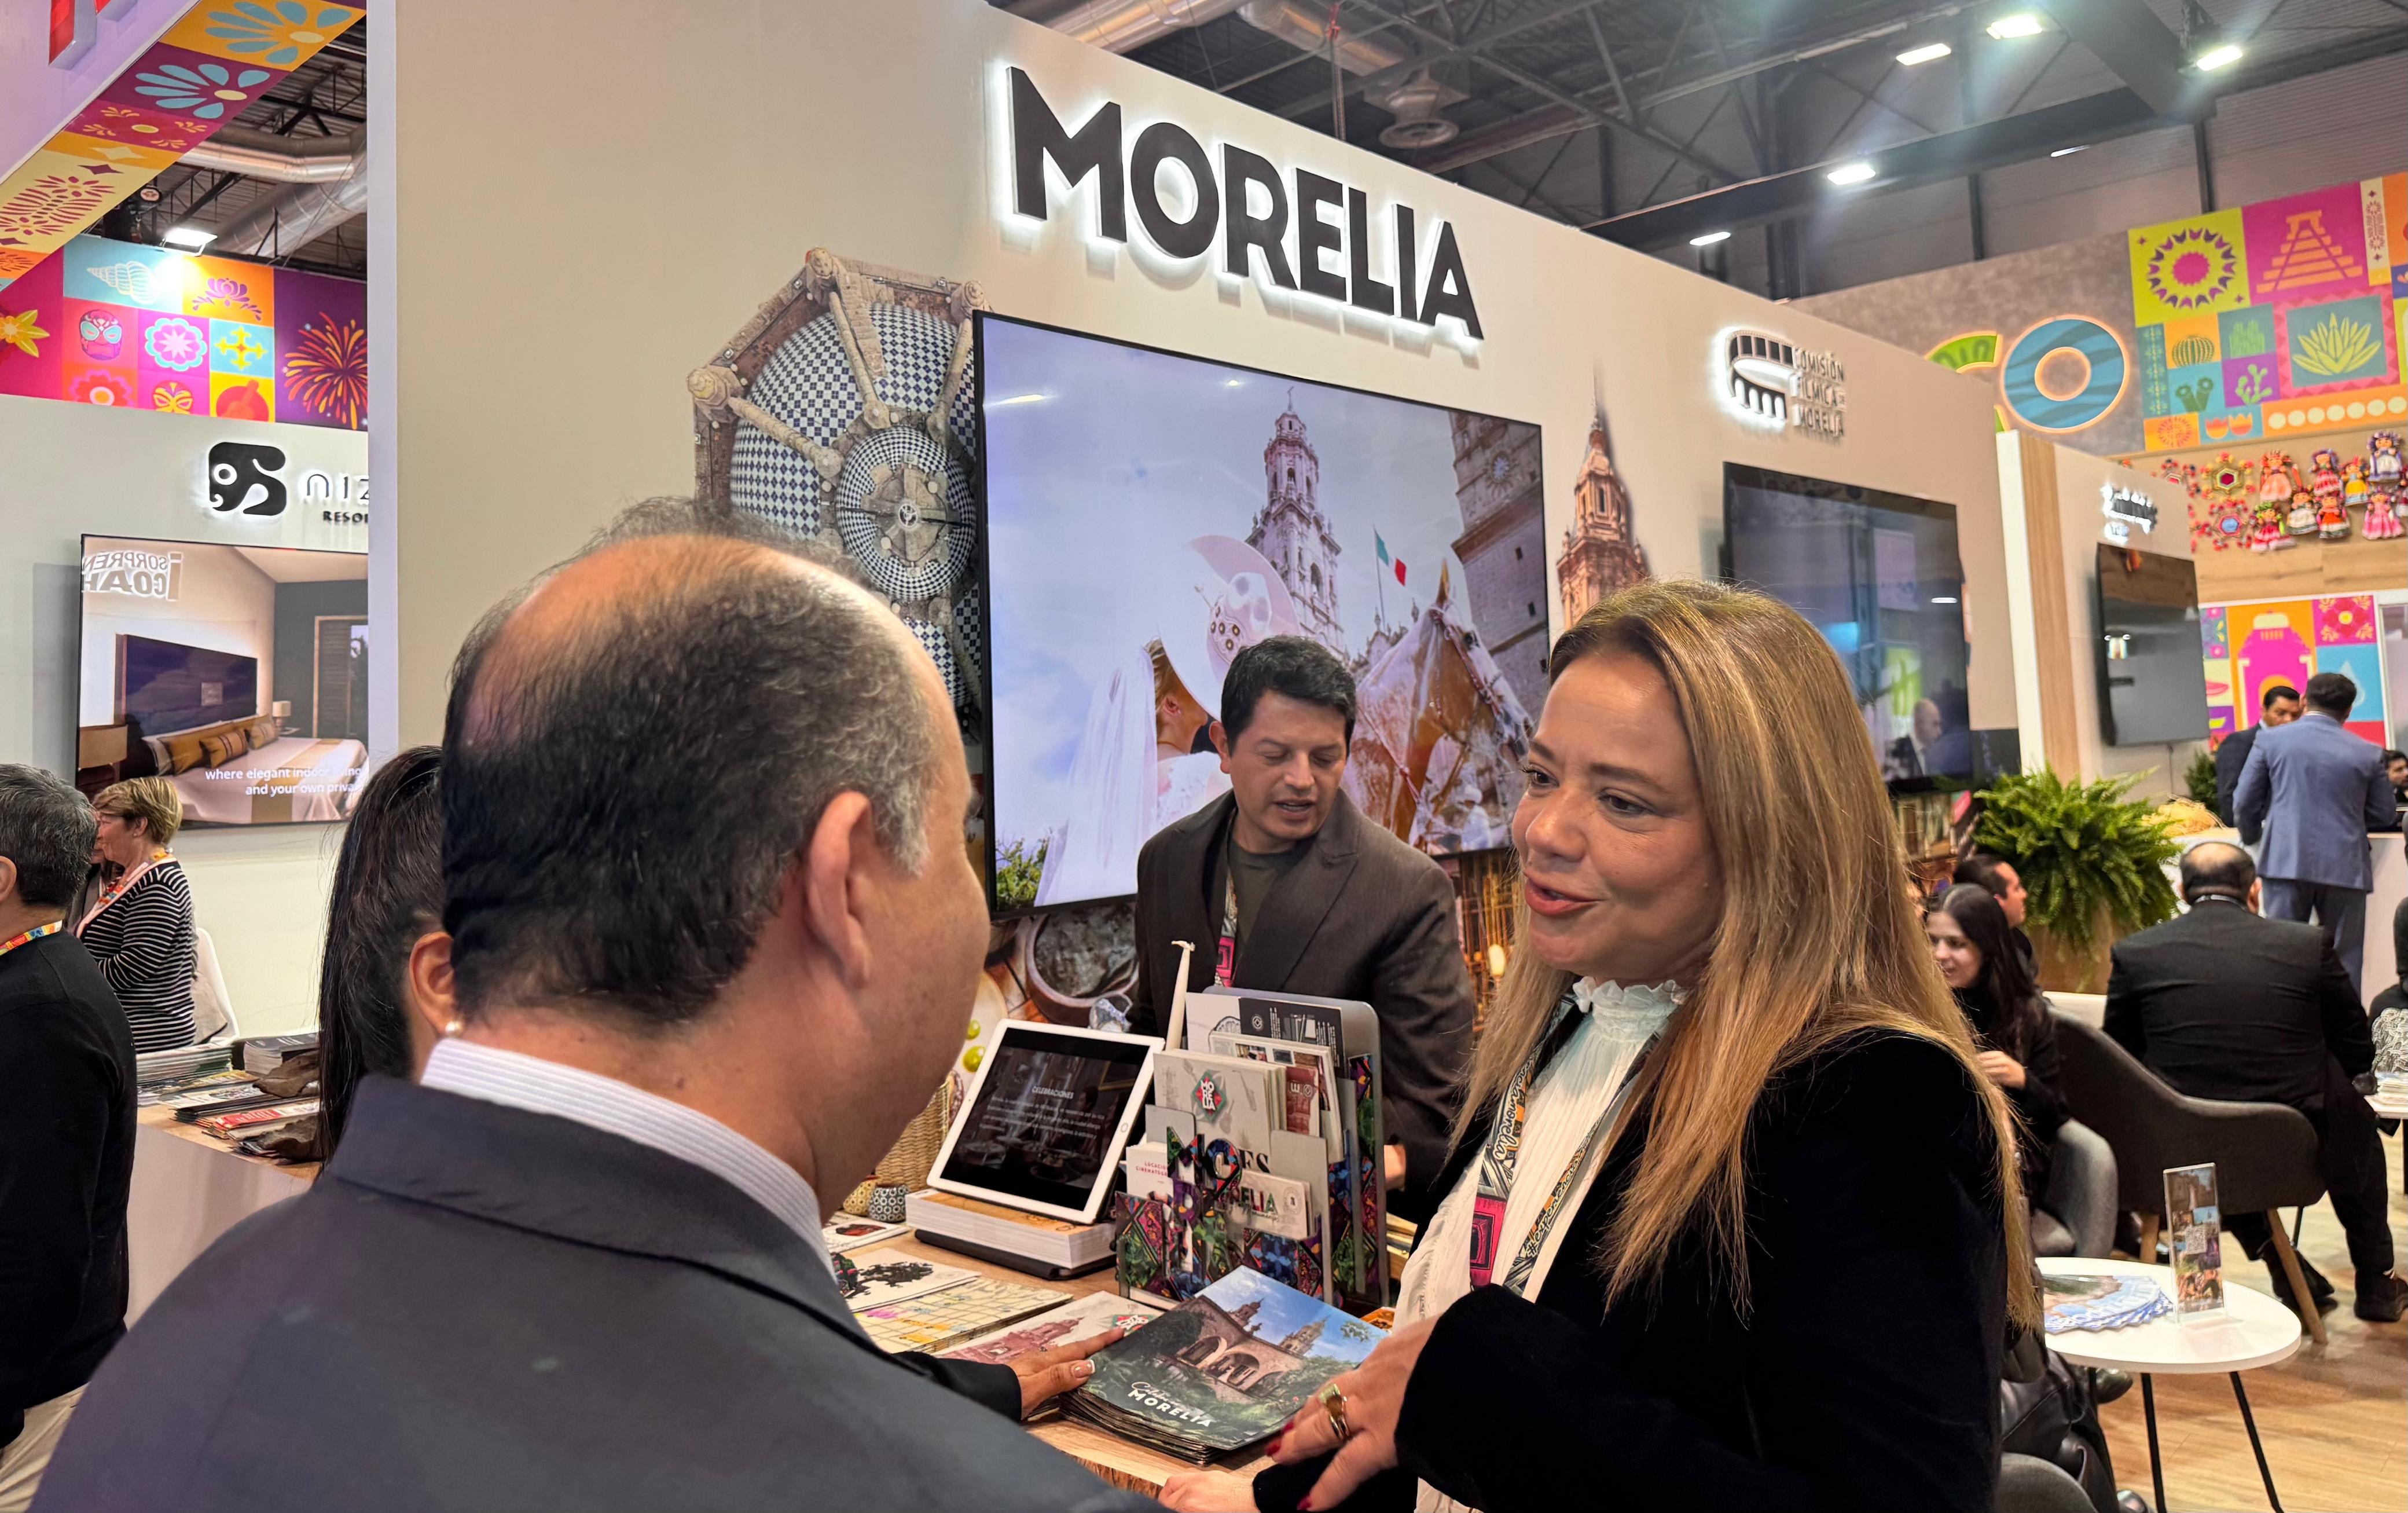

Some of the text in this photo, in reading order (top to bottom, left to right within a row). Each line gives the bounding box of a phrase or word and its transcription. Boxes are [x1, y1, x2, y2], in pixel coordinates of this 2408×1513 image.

[1005, 66, 1484, 340] MORELIA
[205, 767, 243, 780] where
[246, 767, 290, 781] elegant
[245, 783, 358, 797] and your own priva
[1128, 1389, 1211, 1427] MORELIA
